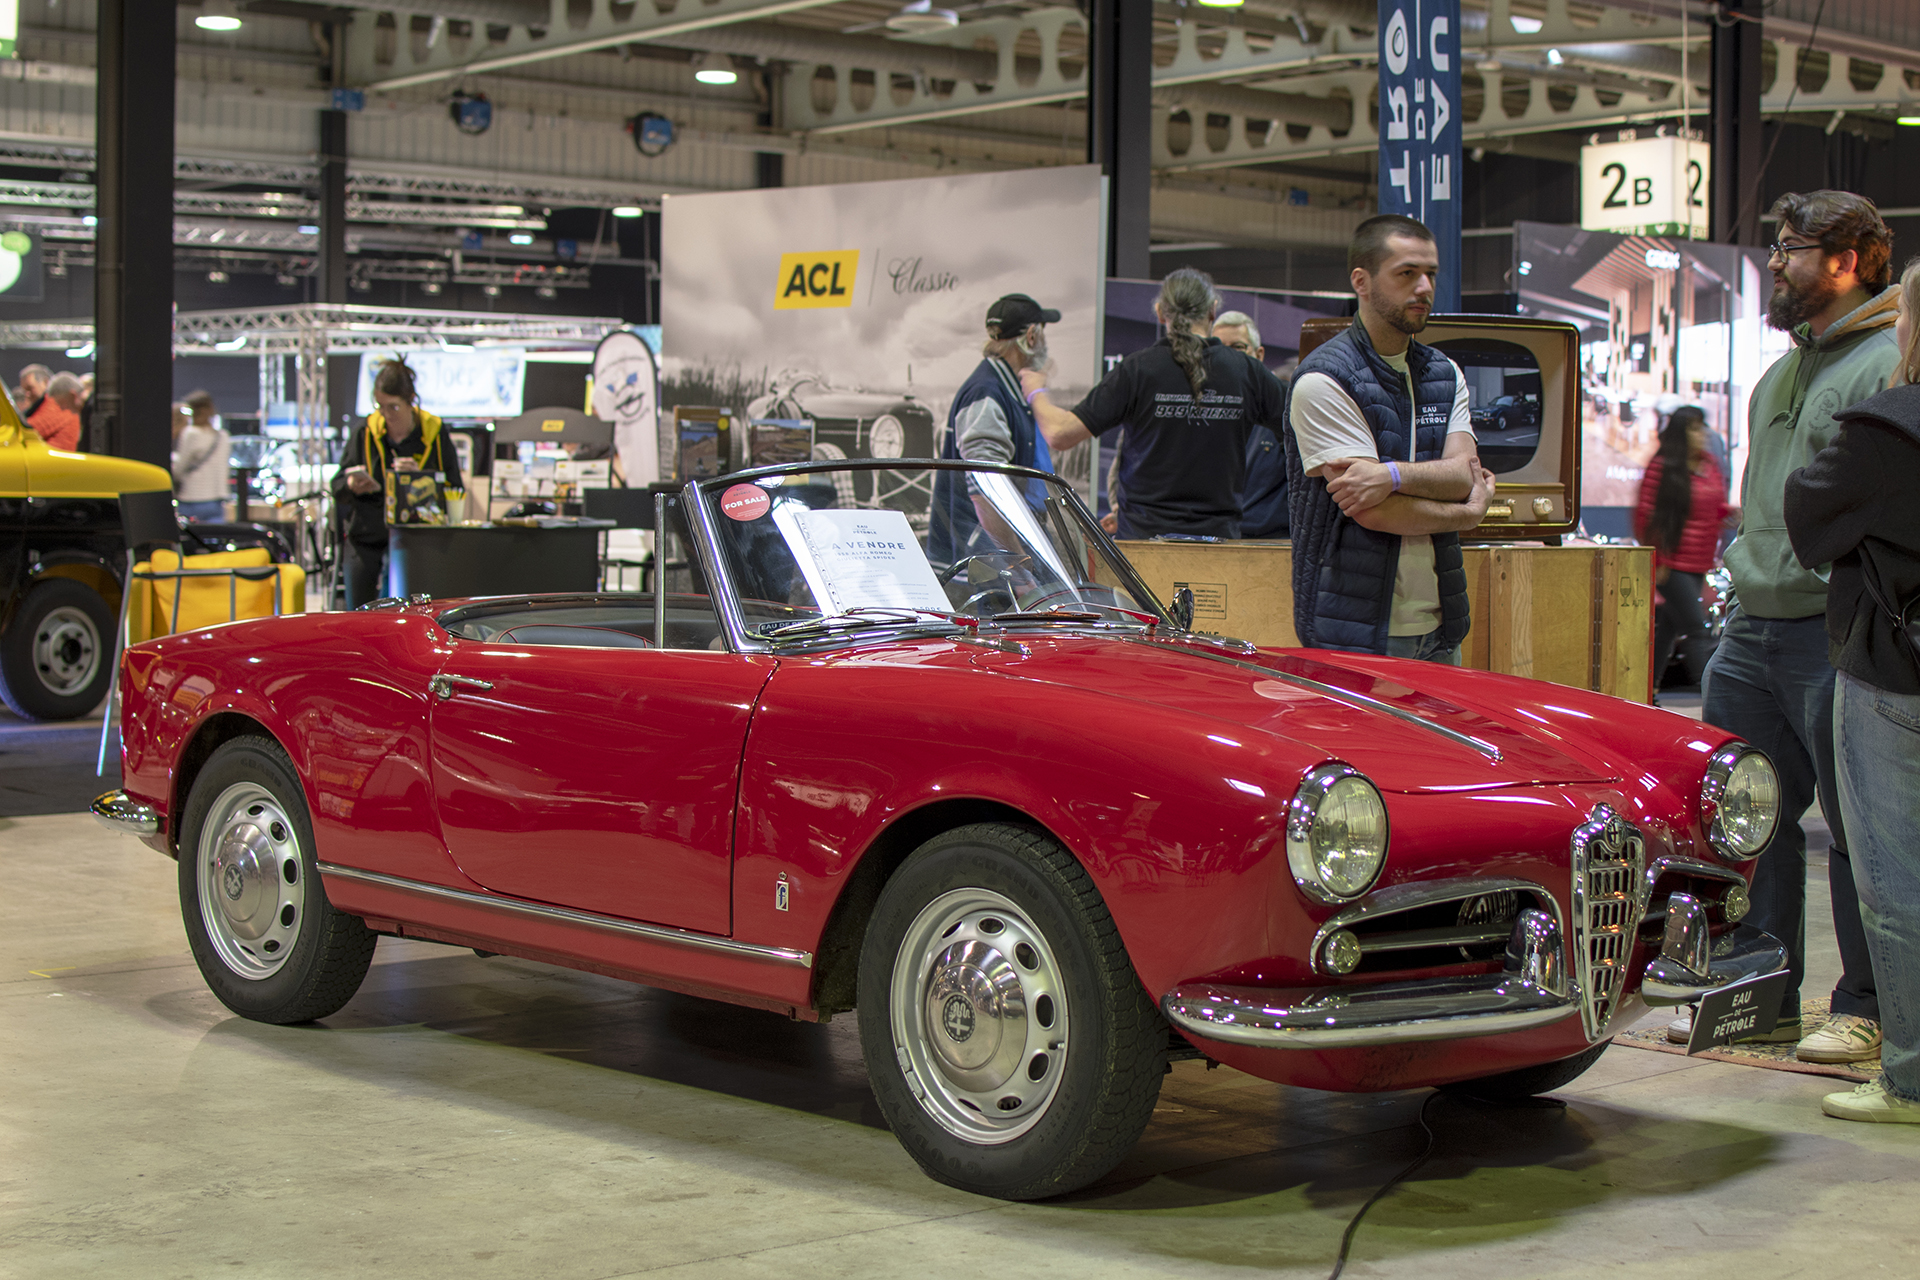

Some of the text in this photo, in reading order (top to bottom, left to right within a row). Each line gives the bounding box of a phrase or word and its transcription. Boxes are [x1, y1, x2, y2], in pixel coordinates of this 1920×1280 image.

[783, 262, 846, 298] ACL
[887, 257, 960, 295] Classic
[1154, 405, 1188, 419] 999
[1421, 405, 1438, 413] EAU
[1415, 415, 1447, 425] PÉTROLE
[724, 495, 768, 510] FOR SALE
[845, 541, 906, 550] VENDRE
[761, 622, 777, 631] EAU
[1731, 990, 1753, 1008] EAU
[1712, 1014, 1757, 1039] PÉTROLE
